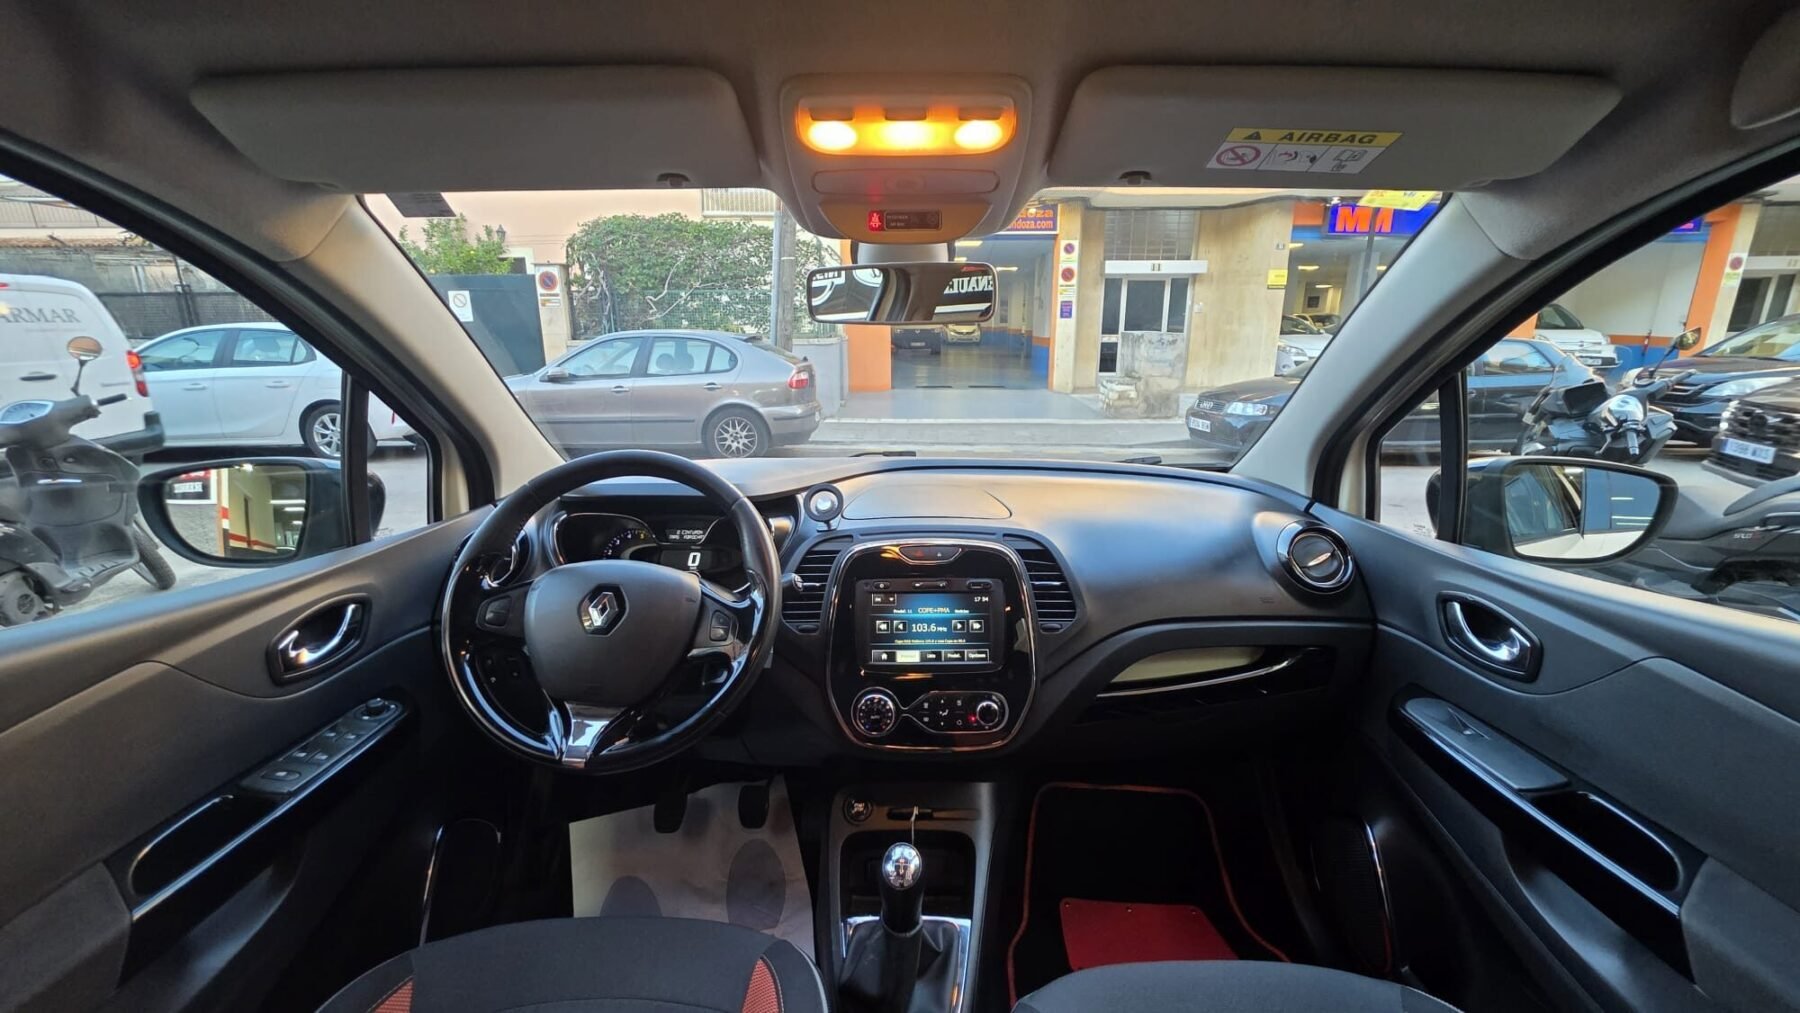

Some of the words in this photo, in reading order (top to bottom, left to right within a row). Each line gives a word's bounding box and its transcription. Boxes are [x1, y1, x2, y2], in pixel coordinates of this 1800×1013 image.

[1278, 132, 1377, 144] AIRBAG
[1008, 218, 1054, 229] ndoza.com
[687, 552, 701, 567] 0
[911, 623, 937, 632] 103.6
